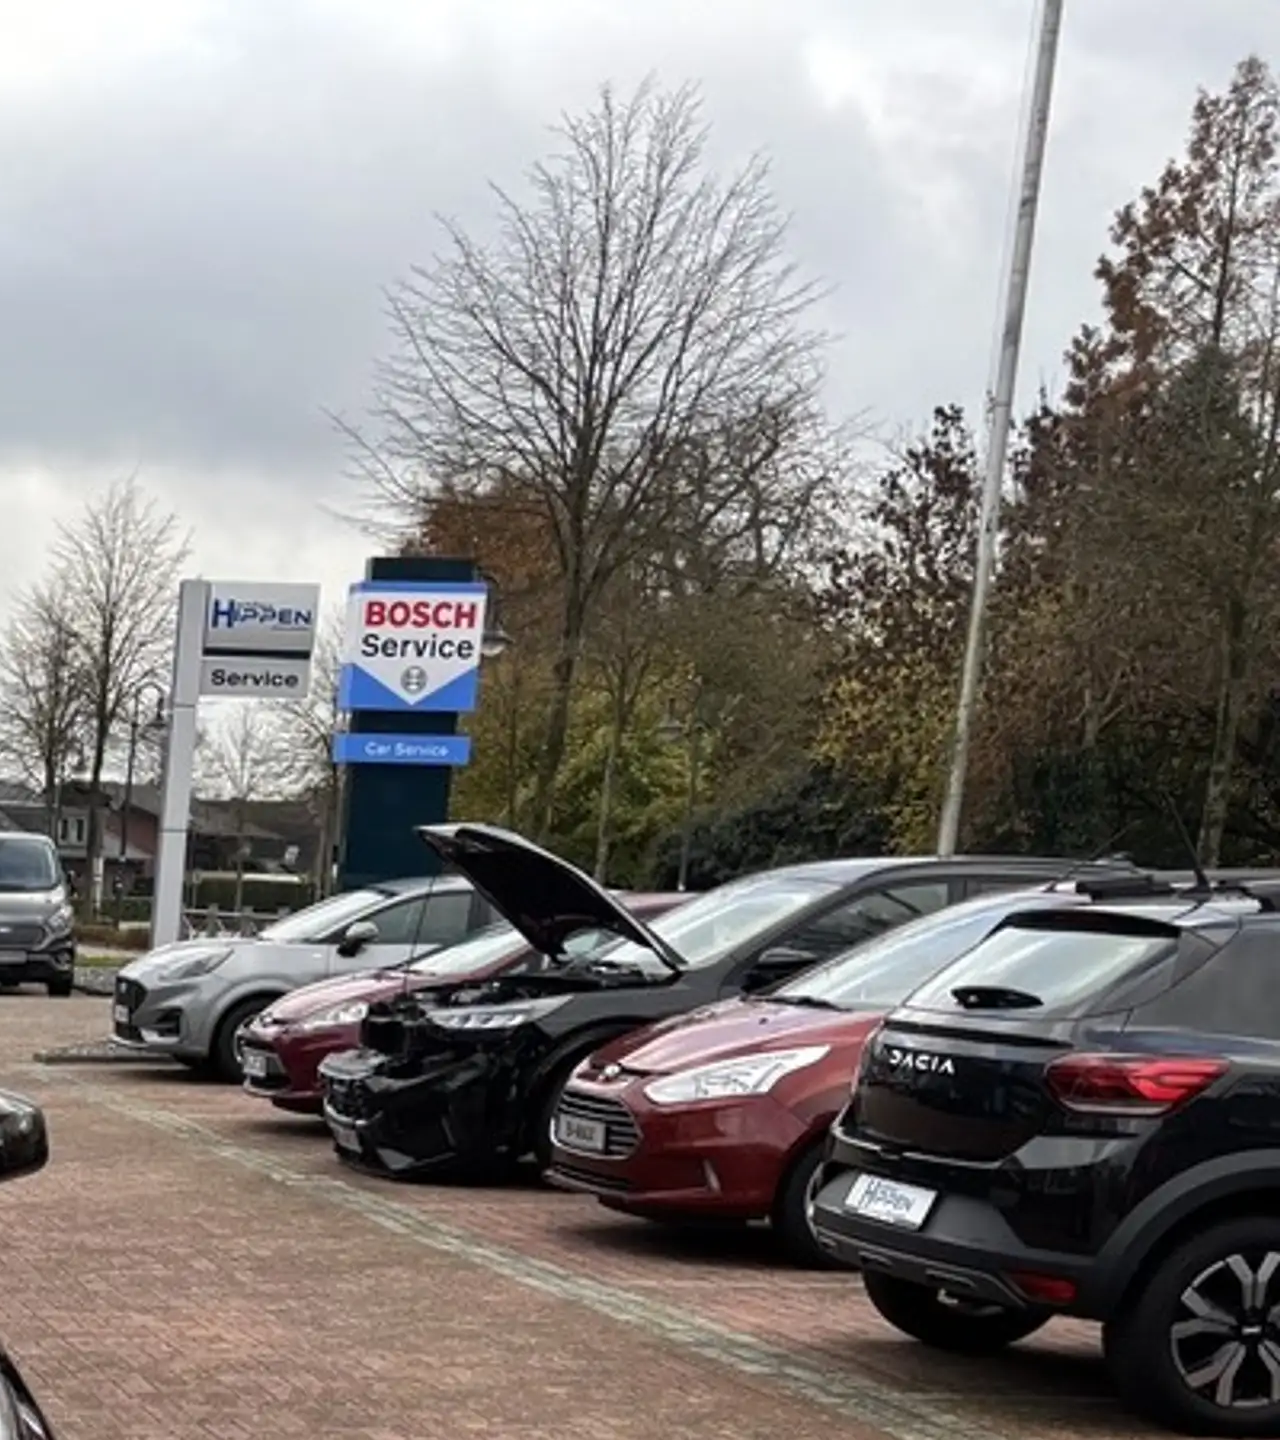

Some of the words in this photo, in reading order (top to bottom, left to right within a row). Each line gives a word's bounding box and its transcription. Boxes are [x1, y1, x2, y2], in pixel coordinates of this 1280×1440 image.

[211, 598, 311, 628] HIPPEN
[365, 601, 476, 628] BOSCH
[361, 632, 474, 659] Service
[211, 668, 299, 688] Service
[365, 741, 391, 757] Car
[394, 742, 449, 757] Service
[889, 1049, 955, 1075] DACIA
